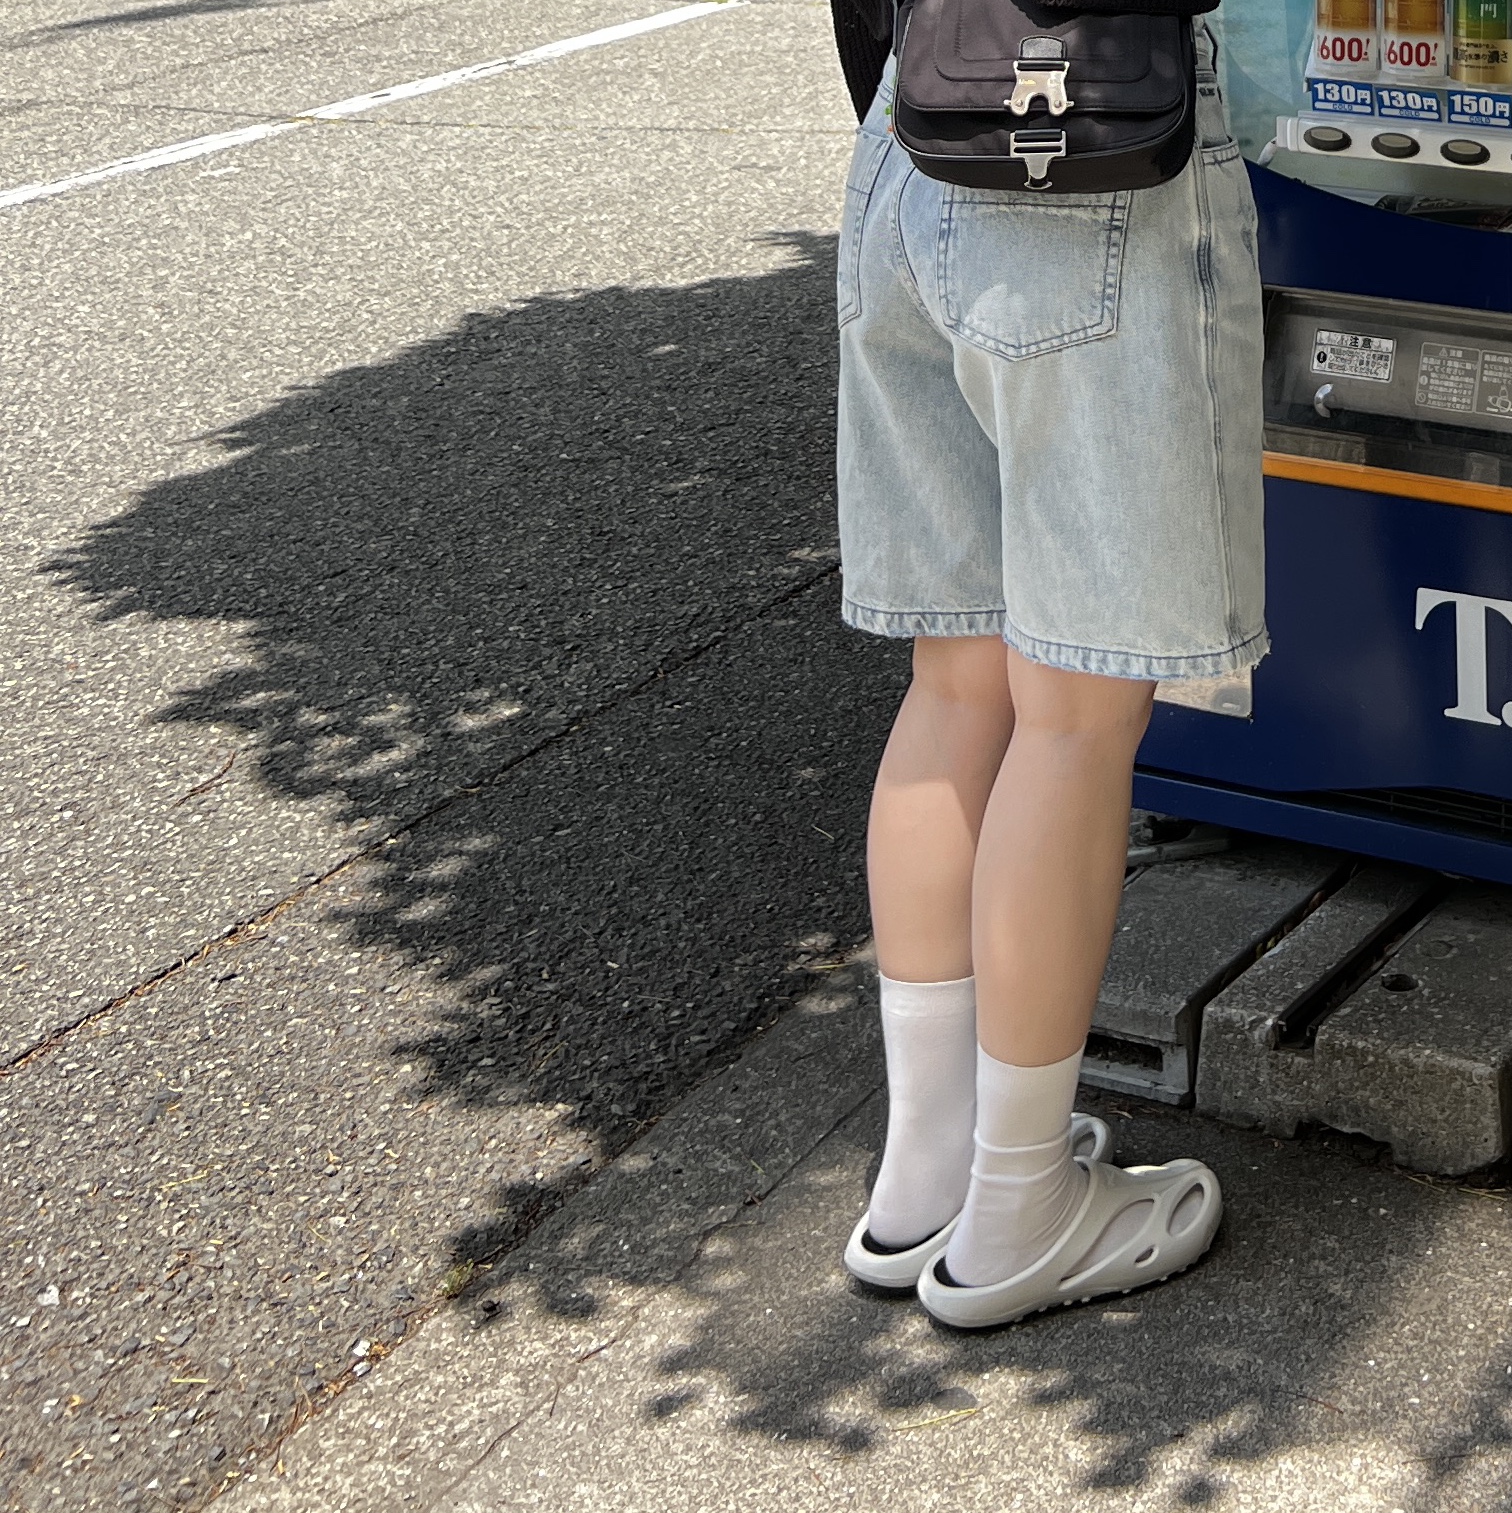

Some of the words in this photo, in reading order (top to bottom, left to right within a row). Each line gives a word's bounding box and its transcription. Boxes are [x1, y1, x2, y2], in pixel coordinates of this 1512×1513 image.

[1320, 37, 1371, 62] 600!
[1387, 41, 1439, 68] 600!
[1313, 82, 1371, 105] 130円
[1378, 90, 1438, 111] 130円
[1450, 94, 1510, 117] 150円
